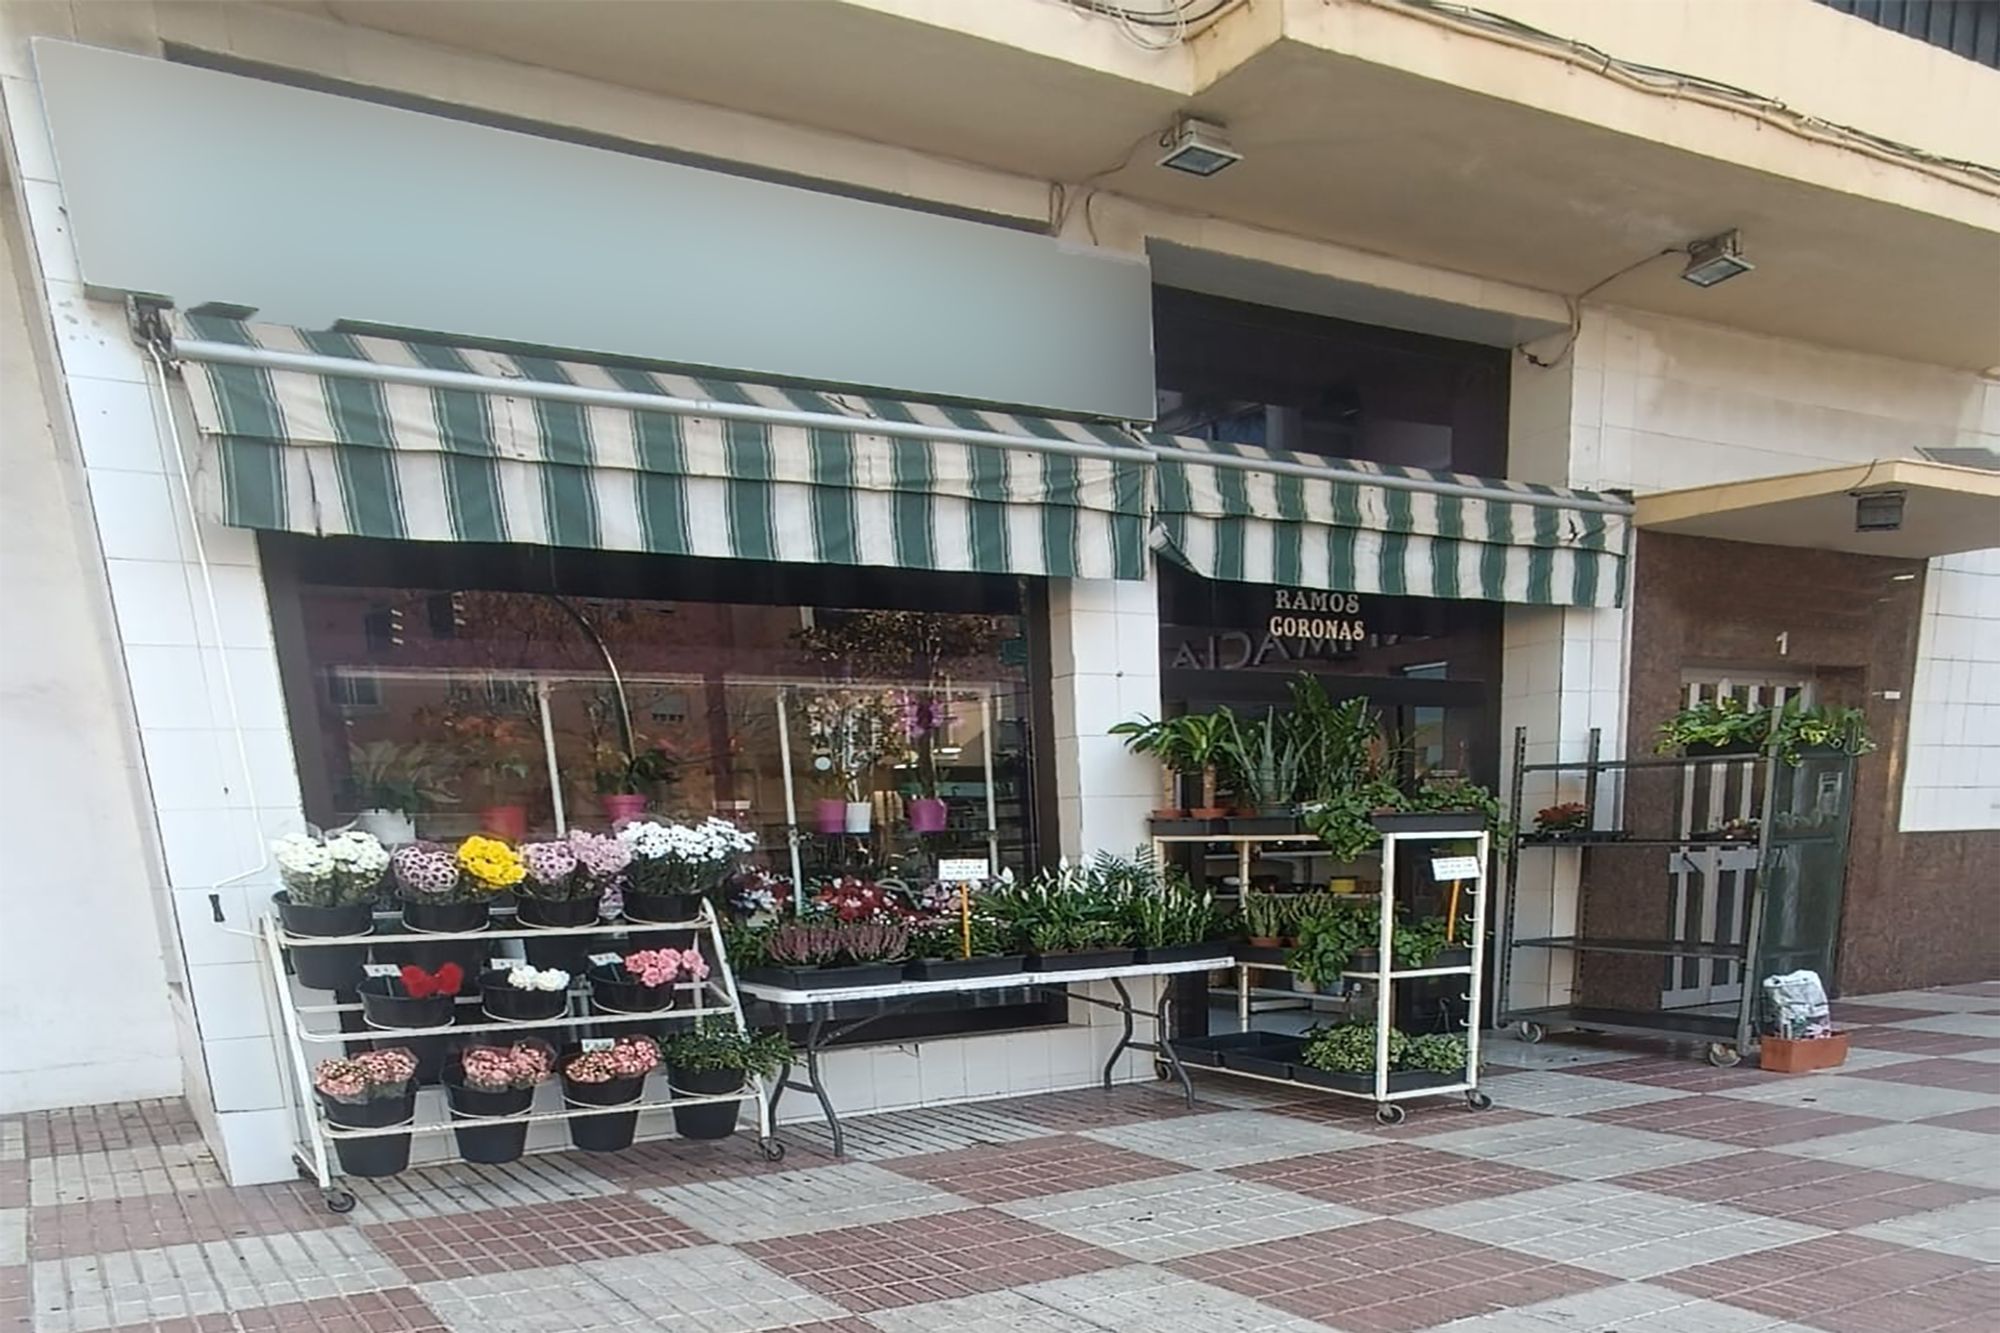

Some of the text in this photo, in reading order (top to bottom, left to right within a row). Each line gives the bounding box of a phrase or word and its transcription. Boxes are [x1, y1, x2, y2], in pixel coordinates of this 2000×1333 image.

[1275, 589, 1360, 614] RAMOS
[1269, 616, 1365, 641] CORONAS
[1776, 631, 1789, 655] 1
